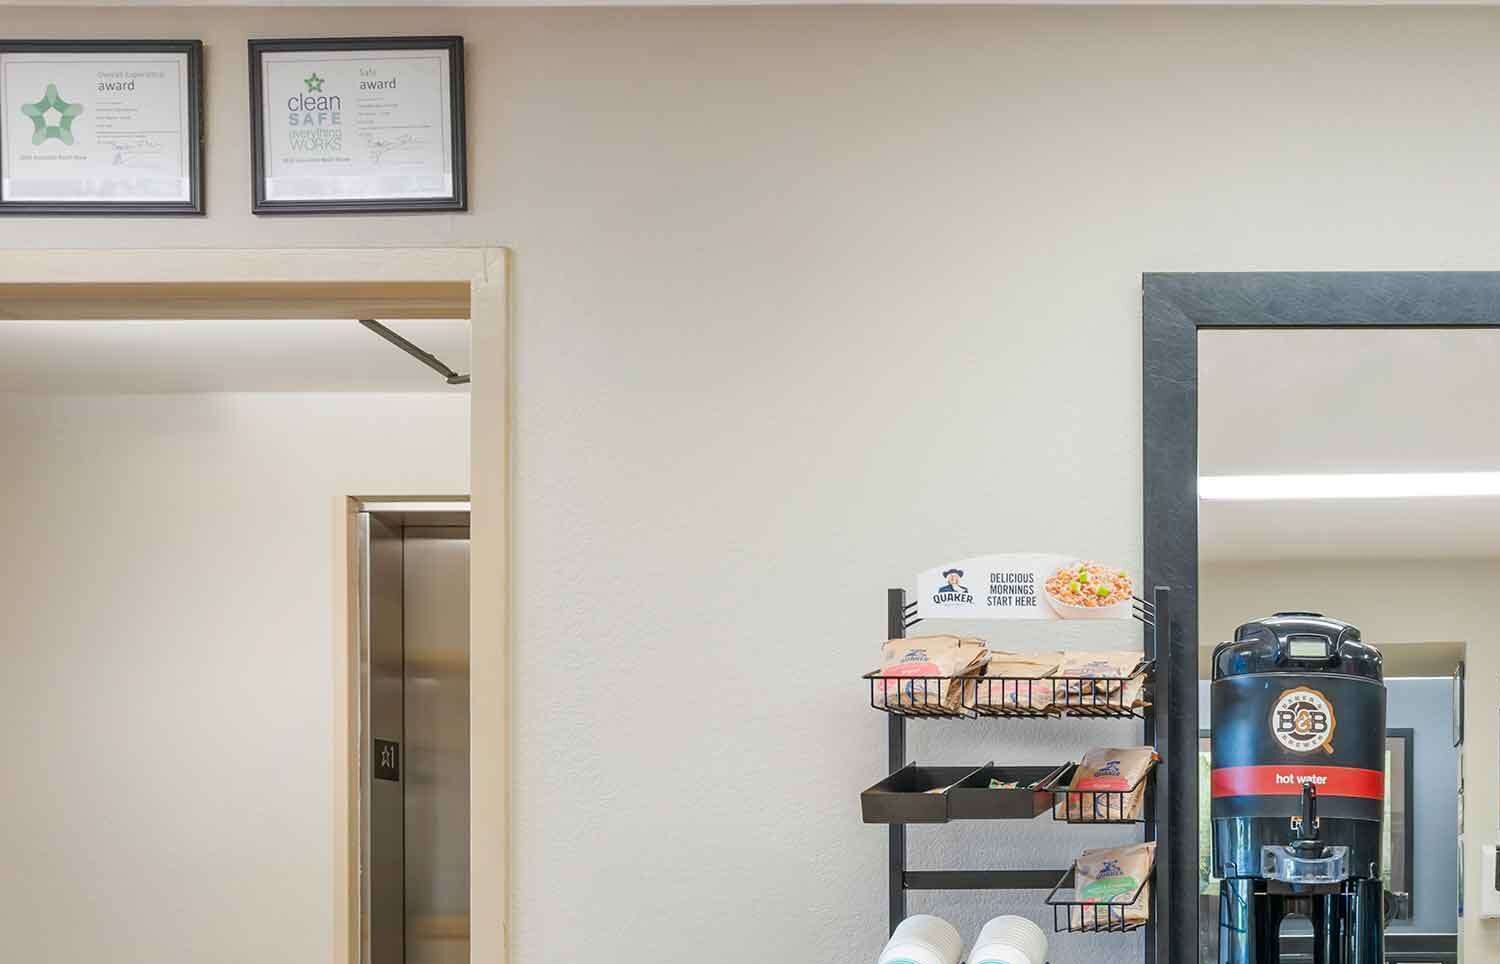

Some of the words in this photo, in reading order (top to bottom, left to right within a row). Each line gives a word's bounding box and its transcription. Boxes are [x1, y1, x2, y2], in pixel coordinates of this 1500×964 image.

[98, 80, 135, 92] award
[359, 77, 397, 90] award
[287, 94, 341, 112] clean
[288, 112, 341, 126] SAFE
[289, 136, 342, 151] WORKS
[990, 573, 1034, 583] DELICIOUS
[990, 584, 1034, 595] MORNINGS
[933, 593, 974, 604] QUAKER
[987, 596, 1012, 606] START
[1015, 596, 1037, 606] HERE
[1277, 709, 1328, 734] B&B
[1276, 773, 1294, 784] hot
[1296, 775, 1328, 785] water
